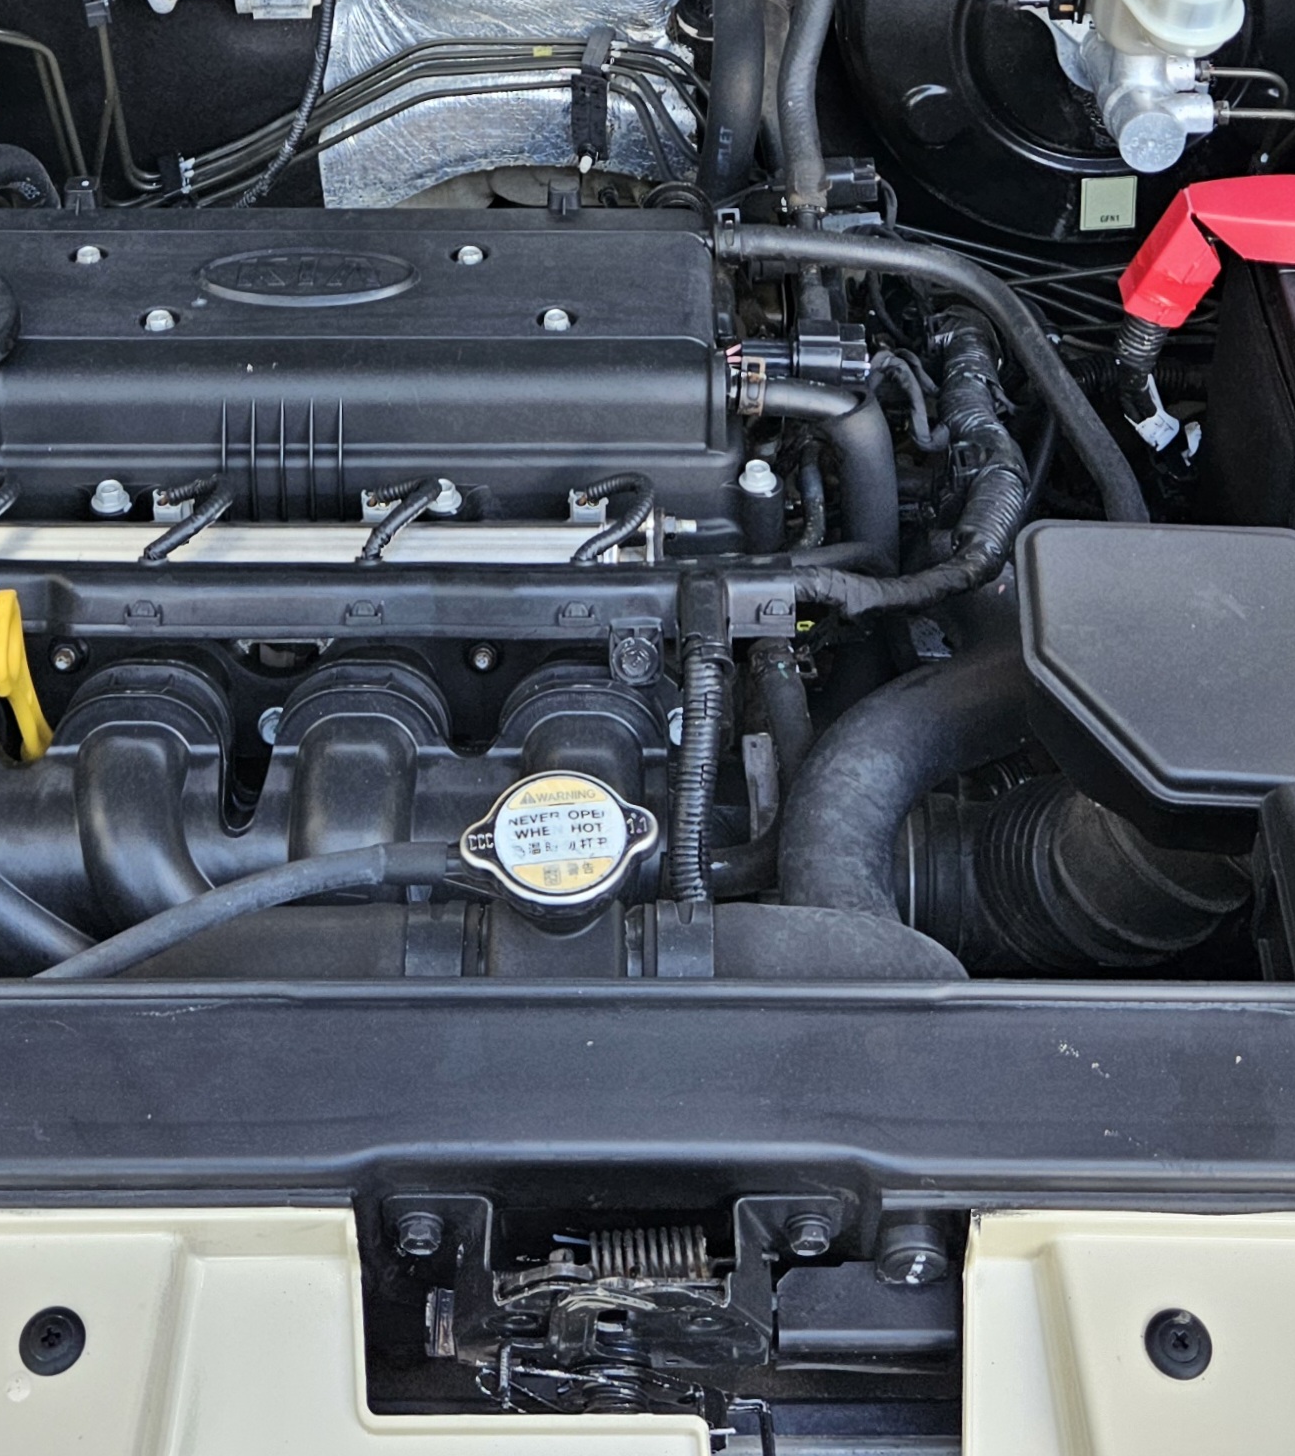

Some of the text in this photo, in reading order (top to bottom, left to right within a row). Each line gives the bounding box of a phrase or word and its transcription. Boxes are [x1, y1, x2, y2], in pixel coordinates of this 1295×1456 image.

[535, 788, 596, 803] WARNING
[567, 809, 606, 819] OPE
[514, 822, 603, 840] WHE HOT
